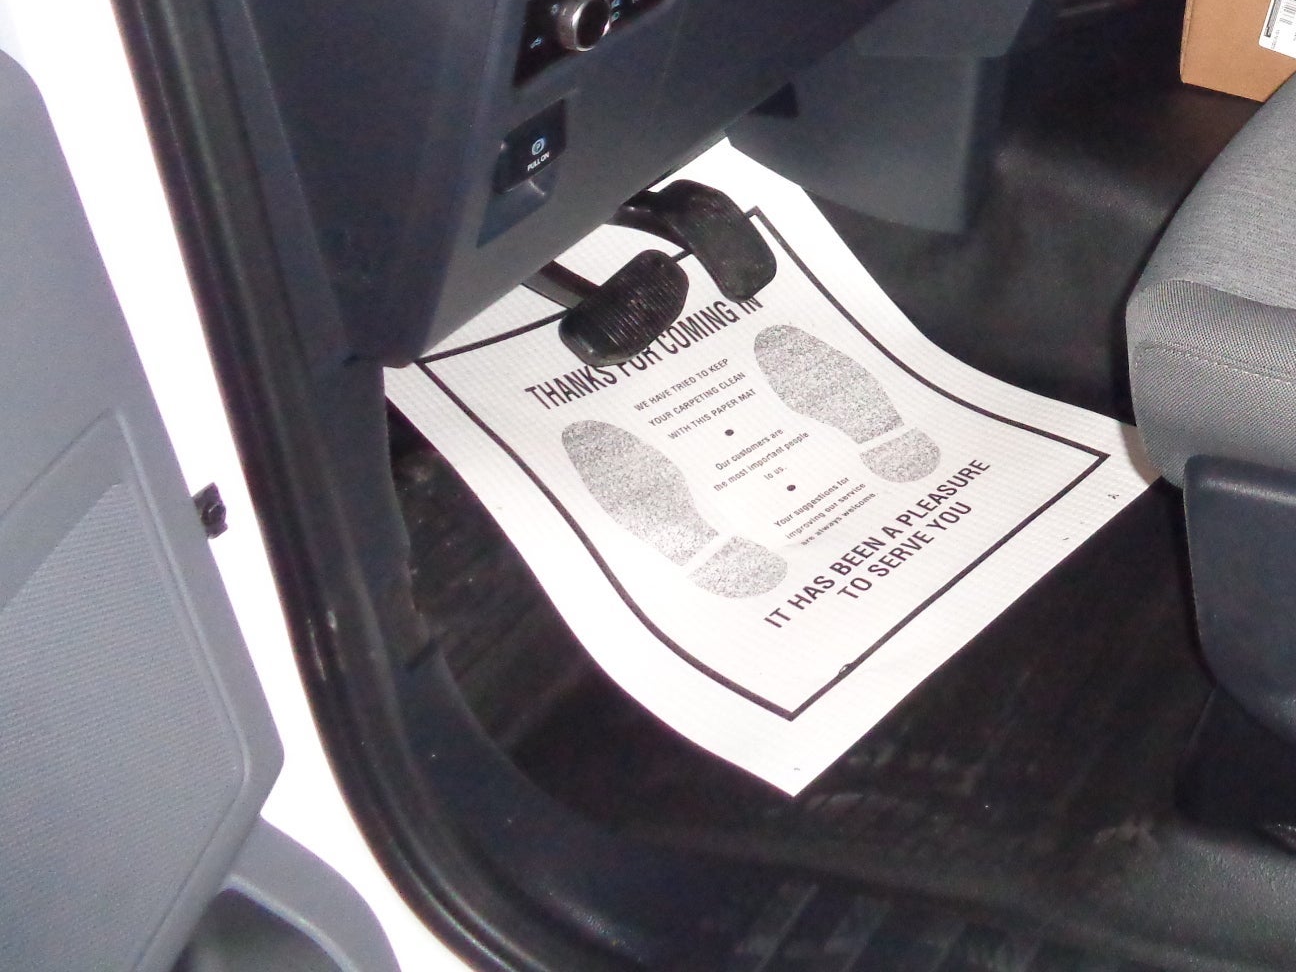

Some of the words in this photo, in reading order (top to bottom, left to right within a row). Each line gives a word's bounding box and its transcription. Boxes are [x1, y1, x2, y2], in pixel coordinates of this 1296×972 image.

[524, 363, 618, 410] THANKS
[659, 301, 741, 355] COMING
[634, 402, 650, 412] WE
[648, 389, 673, 405] HAVE
[671, 376, 697, 394] TRIED
[695, 369, 710, 380] TO
[708, 358, 729, 373] KEEP
[648, 411, 674, 427] YOUR
[673, 386, 720, 415] CARPETING
[718, 371, 746, 389] CLEAN
[668, 424, 692, 440] WITH
[690, 413, 712, 428] THIS
[711, 398, 739, 417] PAPER
[739, 388, 757, 402] MAT
[713, 481, 728, 492] the
[728, 468, 749, 484] most
[748, 446, 785, 472] important
[784, 431, 810, 451] people
[715, 459, 732, 471] Our
[731, 436, 771, 463] customers
[771, 428, 784, 439] are
[763, 472, 774, 481] to
[773, 465, 788, 475] us.
[773, 513, 794, 528] Your
[793, 484, 839, 516] suggestions
[836, 477, 850, 488] for
[785, 512, 826, 540] improving
[824, 502, 839, 513] our
[838, 483, 867, 503] service
[763, 608, 791, 629] IT
[787, 575, 836, 610] HAS
[829, 536, 886, 576] BEEN
[881, 525, 904, 539] A
[896, 459, 991, 527] PLEASURE
[800, 535, 815, 546] are
[815, 516, 843, 537] always
[837, 577, 873, 599] TO
[868, 530, 935, 577] SERVE
[925, 501, 972, 531] YOU
